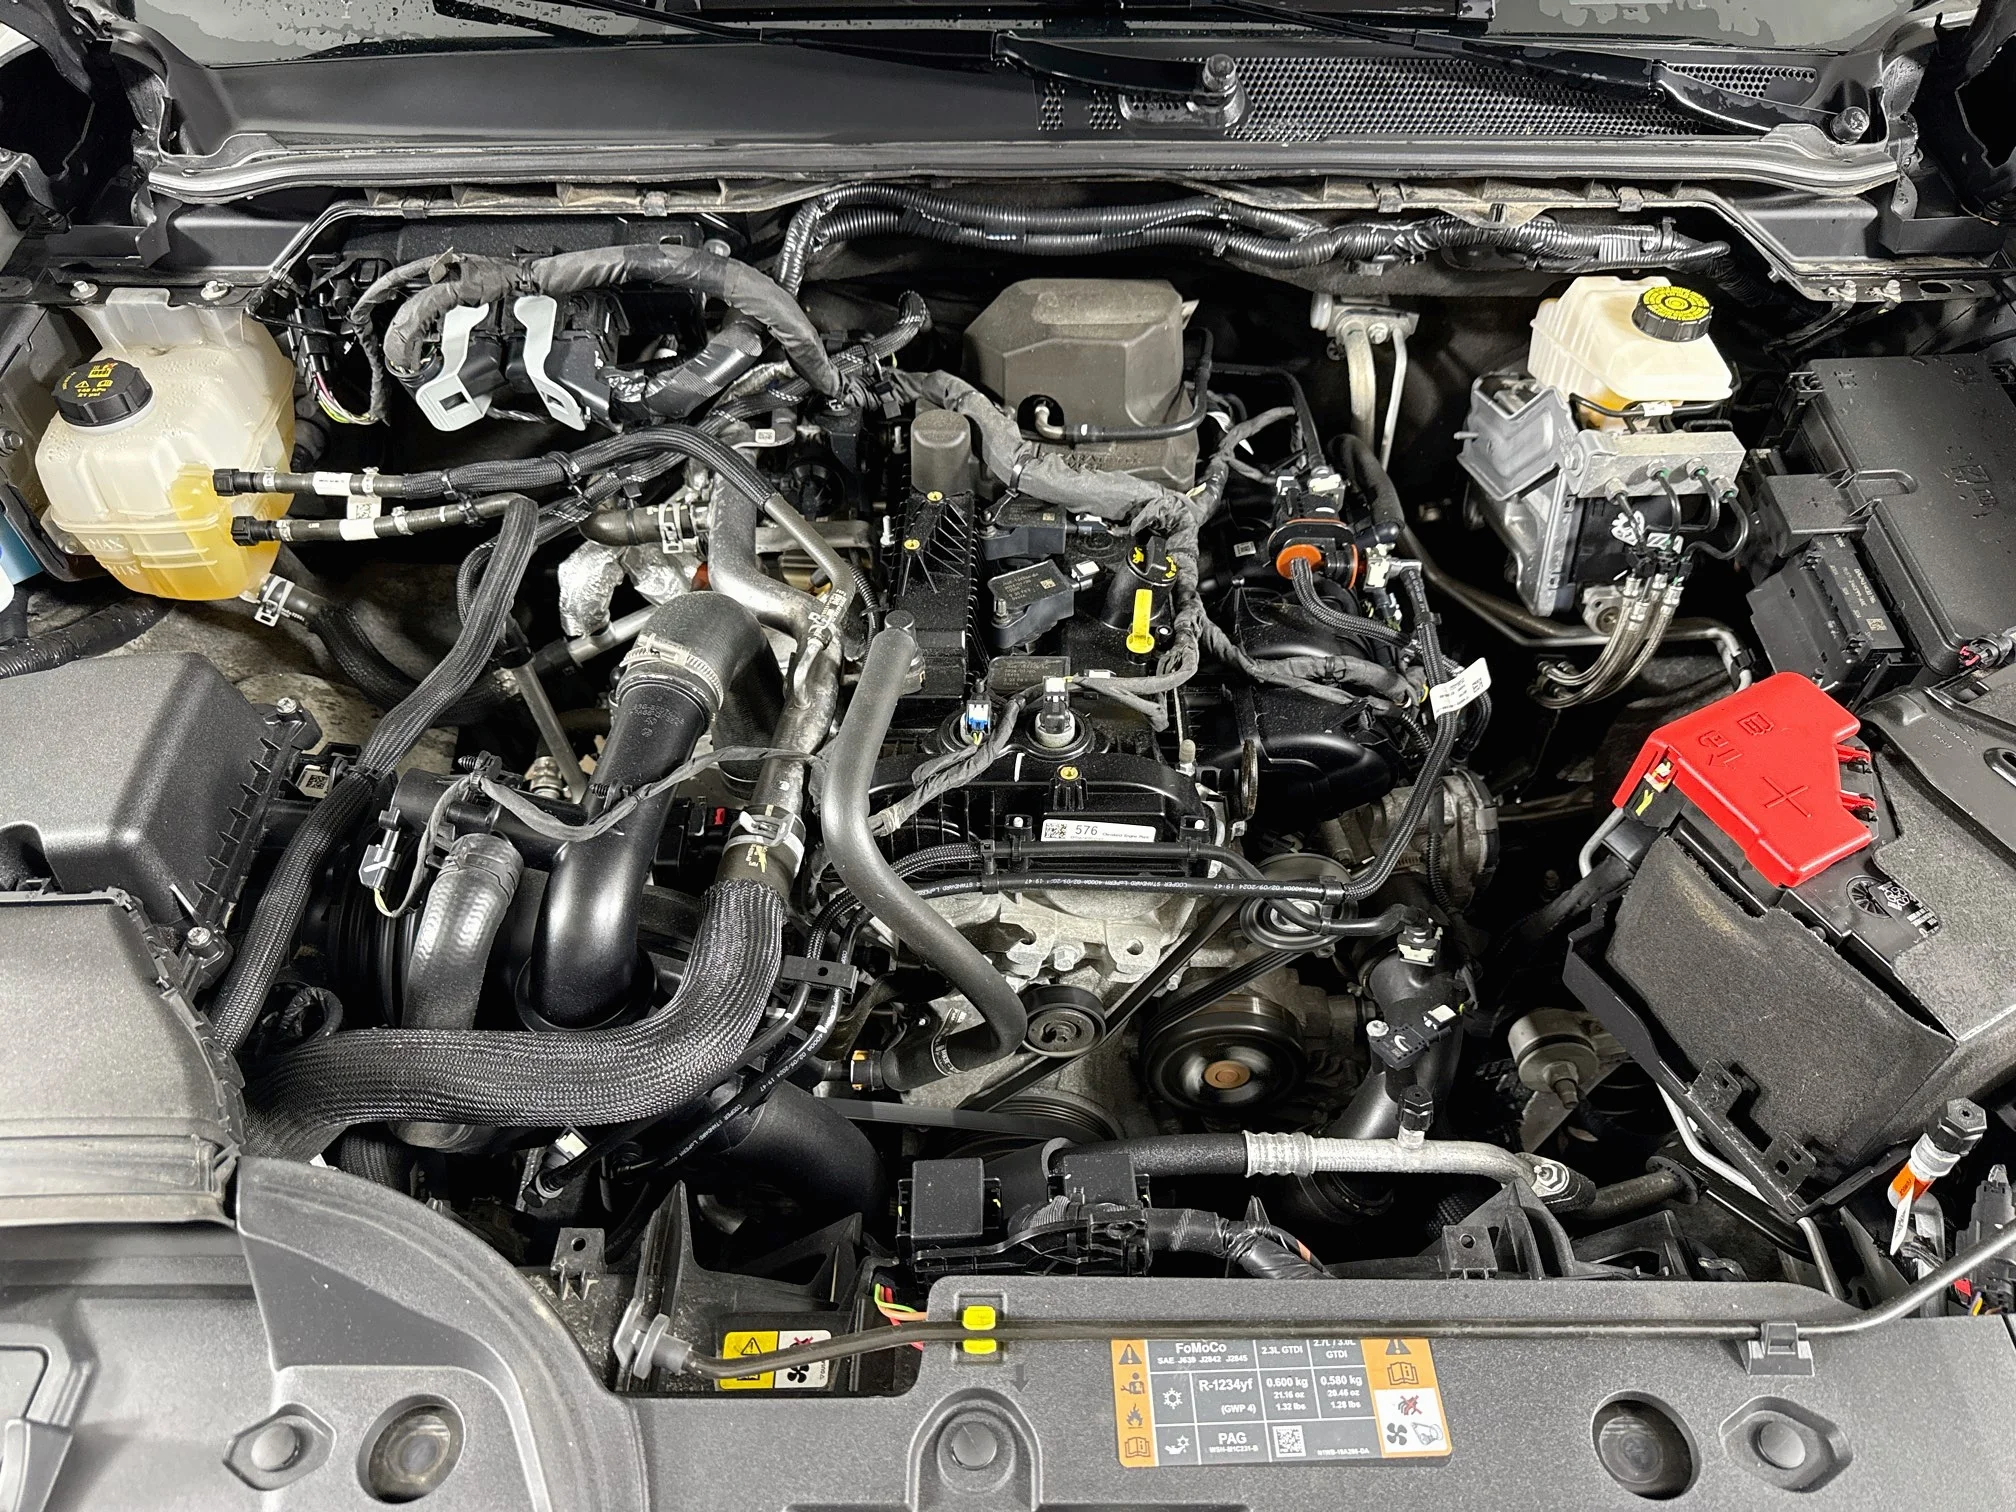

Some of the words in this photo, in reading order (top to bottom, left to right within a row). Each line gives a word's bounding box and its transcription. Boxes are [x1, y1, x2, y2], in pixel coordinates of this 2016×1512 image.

[1075, 824, 1098, 836] 576
[942, 882, 974, 892] STANDARD
[760, 1077, 775, 1092] 19:47
[723, 1104, 742, 1120] COOPER
[1175, 1342, 1227, 1354] FoMoCo
[1261, 1346, 1280, 1354] 2.3L
[1282, 1346, 1304, 1354] GTDI
[1326, 1350, 1348, 1358] GTDI
[1157, 1356, 1175, 1364] SAE
[1198, 1378, 1253, 1392] R-1234yf
[1266, 1378, 1294, 1388] 0.600
[1295, 1376, 1308, 1388] kg
[1320, 1376, 1348, 1386] 0.580
[1349, 1374, 1362, 1386] kg
[1274, 1390, 1294, 1399] 21.16
[1221, 1404, 1246, 1416] (GWP
[1247, 1404, 1257, 1414] 4)
[1276, 1402, 1292, 1411] 1.32
[1292, 1402, 1306, 1410] lbs
[1348, 1400, 1361, 1408] lbs
[1218, 1432, 1248, 1445] PAG
